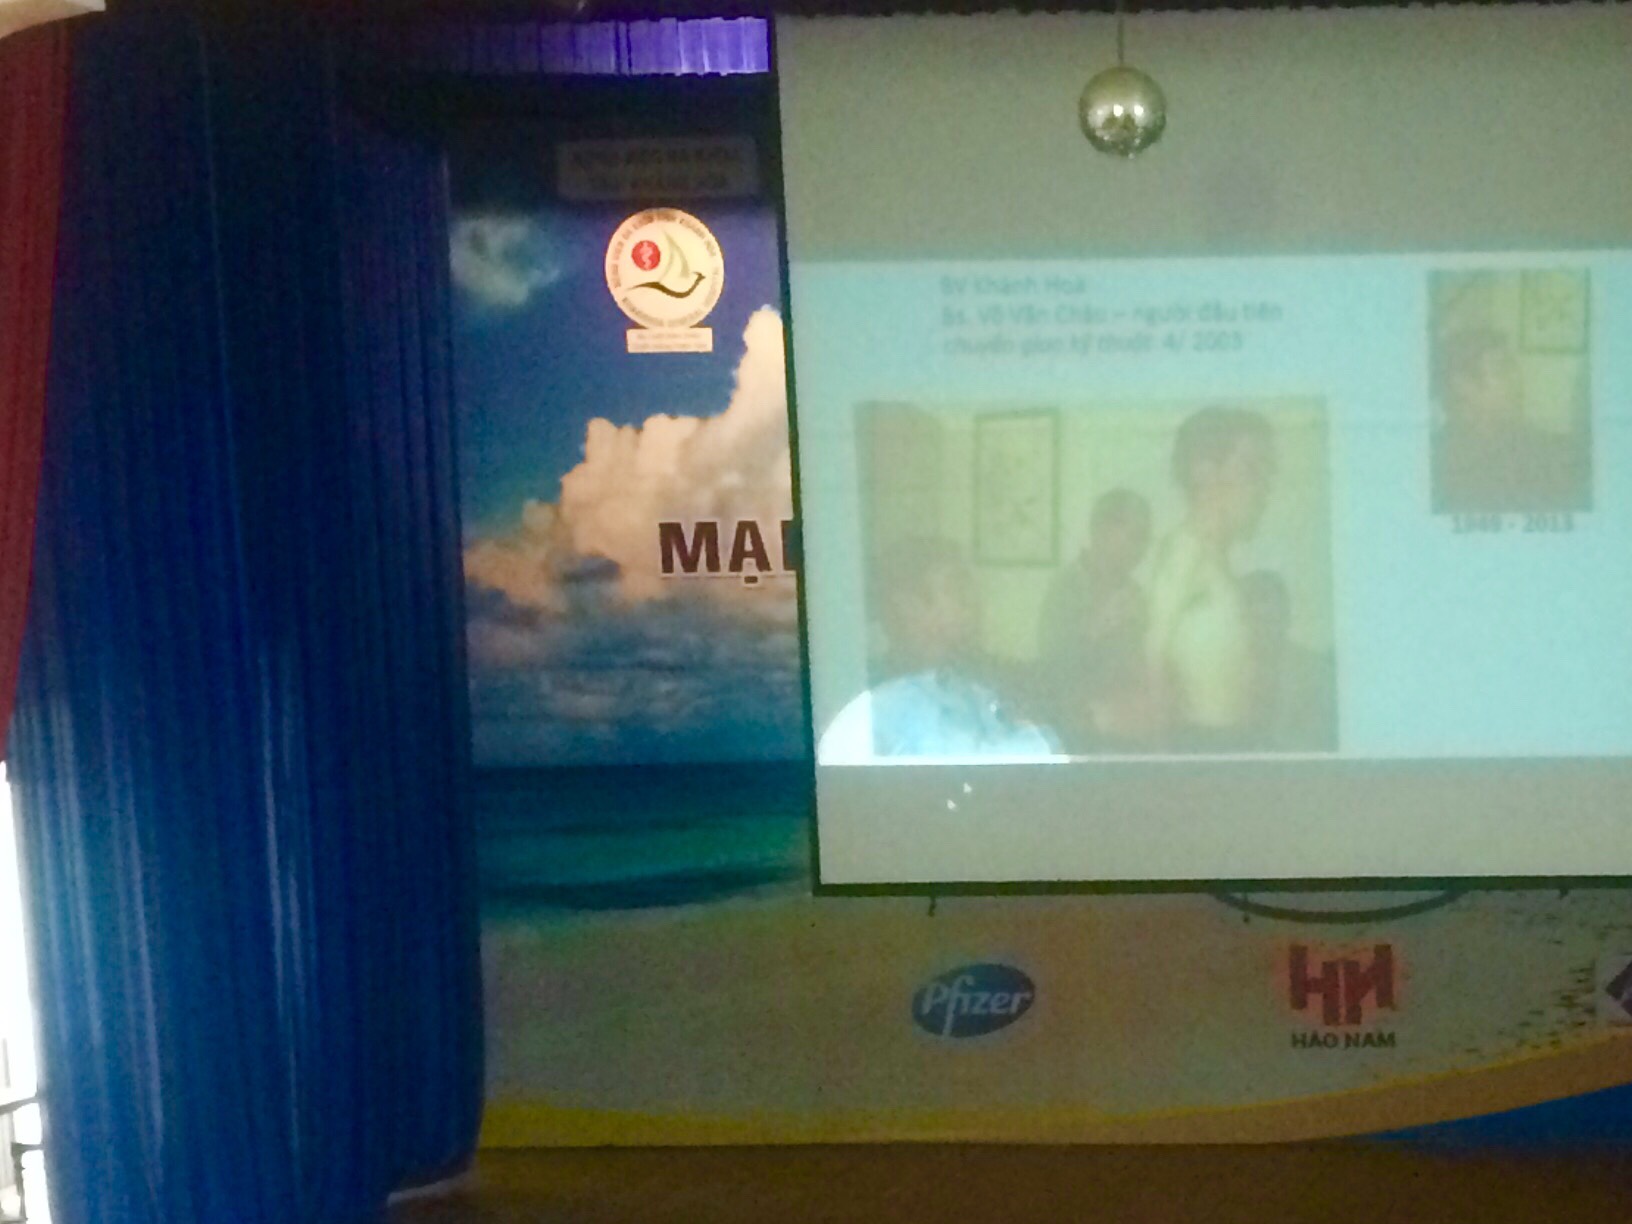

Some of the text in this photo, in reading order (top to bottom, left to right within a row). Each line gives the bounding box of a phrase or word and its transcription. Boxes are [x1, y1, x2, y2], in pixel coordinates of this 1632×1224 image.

[658, 519, 799, 584] MẠ
[922, 974, 1034, 1038] Pfizer
[1344, 1029, 1396, 1049] NAM
